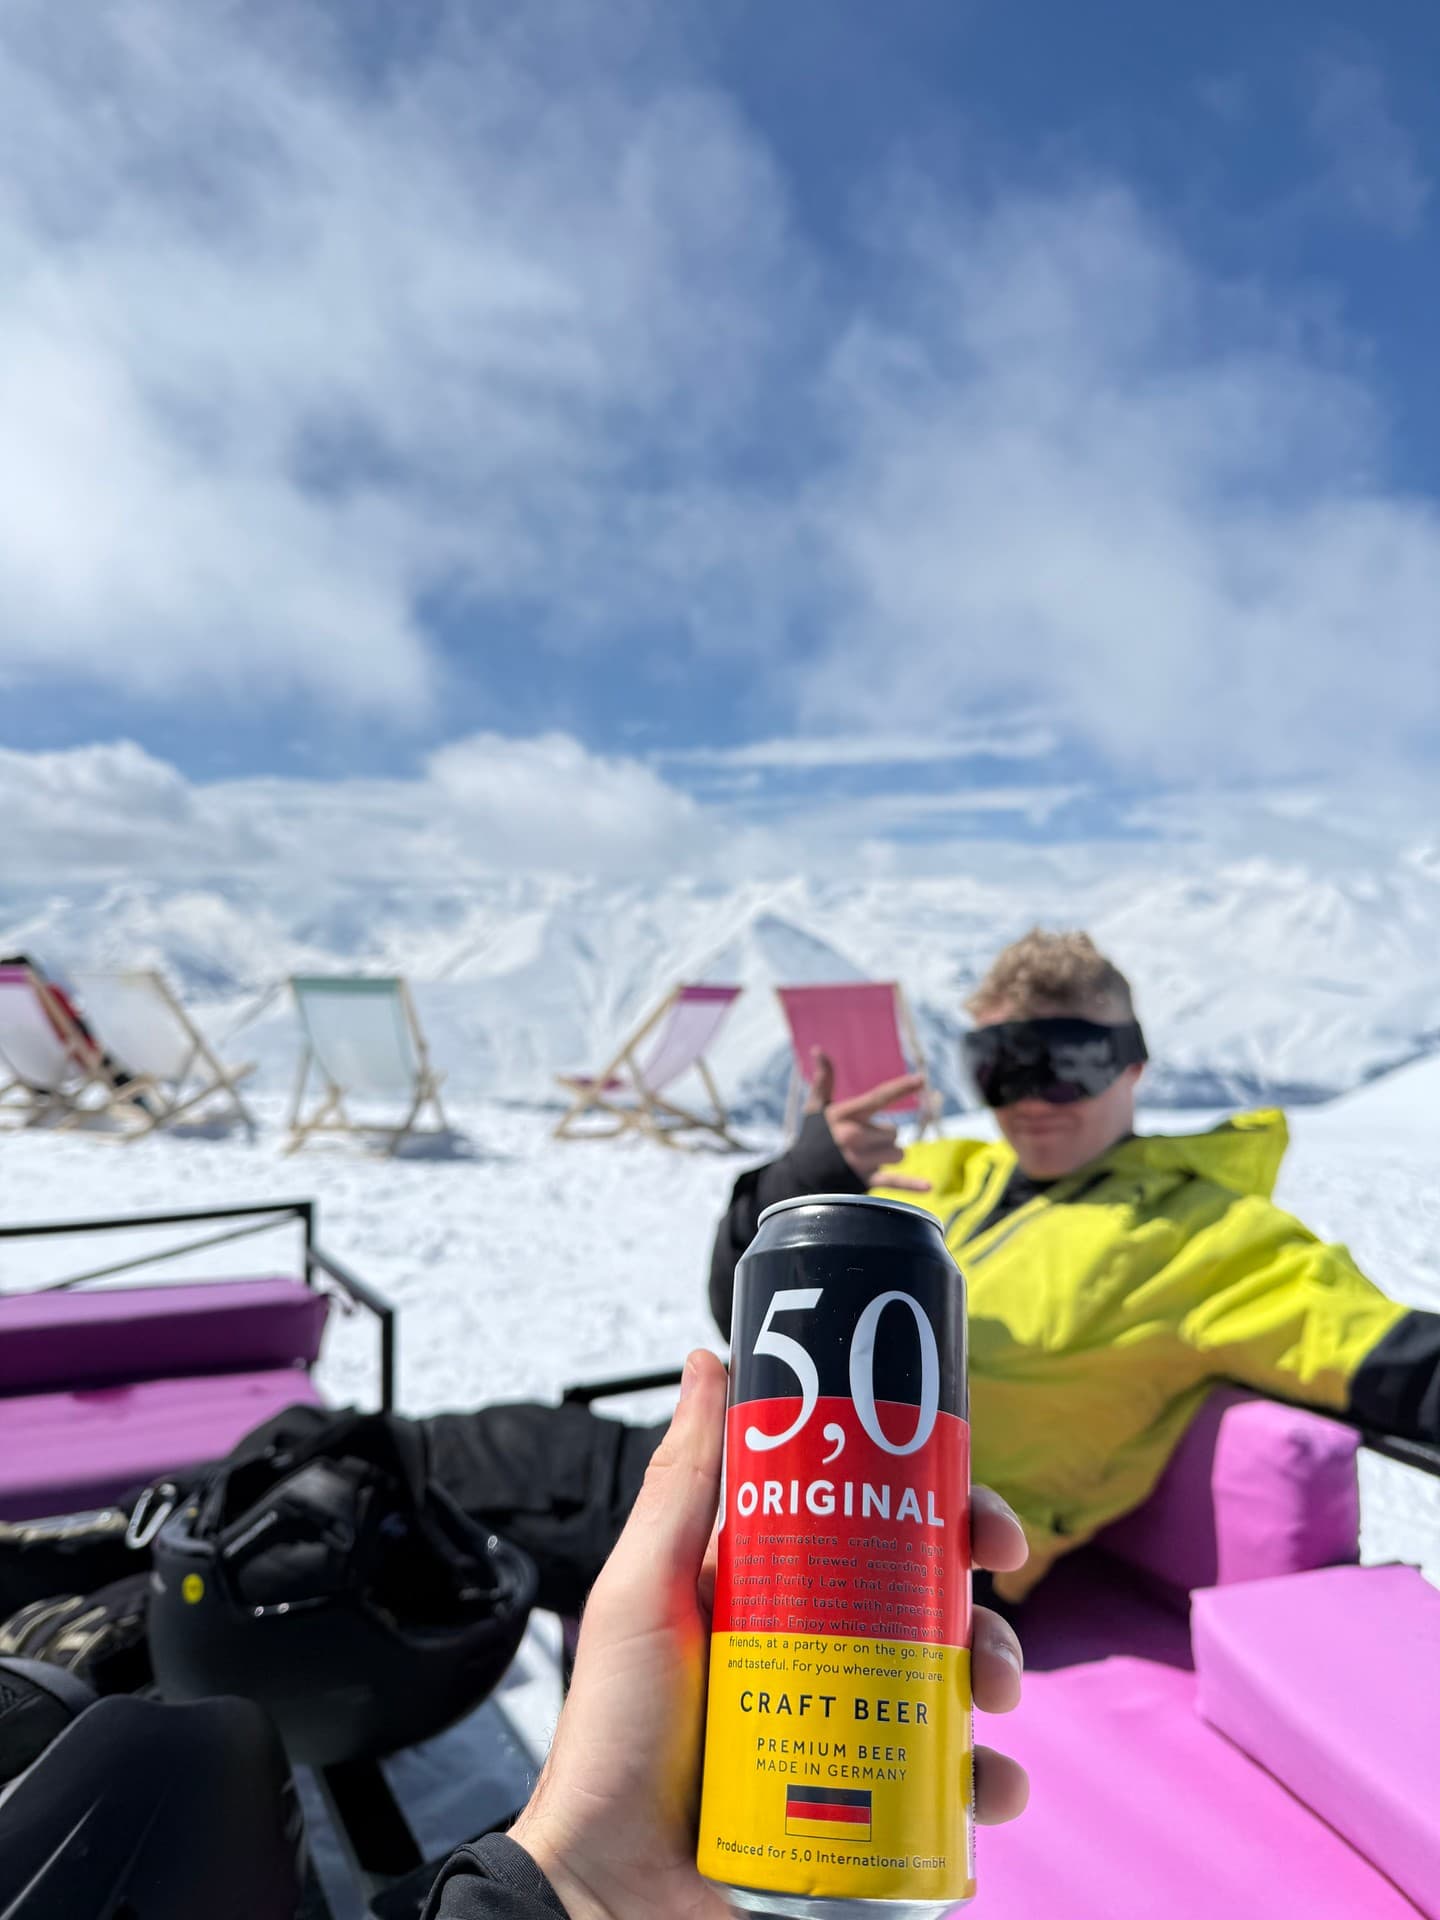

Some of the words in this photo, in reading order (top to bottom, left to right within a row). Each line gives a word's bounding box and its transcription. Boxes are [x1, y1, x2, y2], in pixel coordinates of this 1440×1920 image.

[745, 1287, 939, 1464] 5,0
[737, 1479, 944, 1527] ORIGINAL
[758, 1534, 838, 1546] brewmasters
[848, 1536, 897, 1550] crafted
[906, 1542, 912, 1552] a
[921, 1542, 943, 1557] light
[734, 1554, 765, 1568] golden
[771, 1552, 800, 1565] beer
[808, 1553, 857, 1567] brewed
[867, 1559, 927, 1577] according
[934, 1564, 943, 1576] to
[733, 1574, 771, 1585] German
[776, 1573, 813, 1588] Purity
[820, 1575, 847, 1588] Law
[854, 1578, 882, 1590] that
[888, 1581, 934, 1596] delivers
[938, 1587, 943, 1597] a
[813, 1597, 848, 1609] taste
[853, 1599, 881, 1610] with
[886, 1603, 892, 1612] a
[896, 1603, 944, 1617] precious
[730, 1616, 746, 1628] hop
[788, 1615, 825, 1631] Enjoy
[829, 1619, 866, 1632] while
[871, 1621, 918, 1638] chilling
[921, 1625, 943, 1638] with
[729, 1636, 762, 1649] friends,
[767, 1638, 777, 1649] at
[782, 1641, 789, 1649] a
[794, 1640, 828, 1654] party
[833, 1643, 847, 1652] or
[853, 1644, 869, 1654] on
[875, 1644, 896, 1656] the
[901, 1648, 918, 1659] go.
[922, 1647, 944, 1660] Pure
[728, 1657, 743, 1669] and
[745, 1658, 788, 1671] tasteful.
[793, 1659, 812, 1672] For
[815, 1663, 839, 1675] you
[843, 1664, 902, 1678] wherever
[905, 1671, 925, 1682] you
[740, 1690, 837, 1718] CRAFT
[854, 1697, 928, 1725] BEER
[757, 1737, 847, 1758] PREMIUM
[858, 1745, 907, 1761] BEER
[756, 1758, 798, 1774] MADE
[804, 1762, 821, 1775] IN
[827, 1764, 908, 1781] GERMANY
[716, 1837, 763, 1856] Produced
[768, 1846, 785, 1859] for
[790, 1849, 812, 1863] 5,0
[816, 1851, 909, 1868] International
[912, 1856, 947, 1869] GmbH
